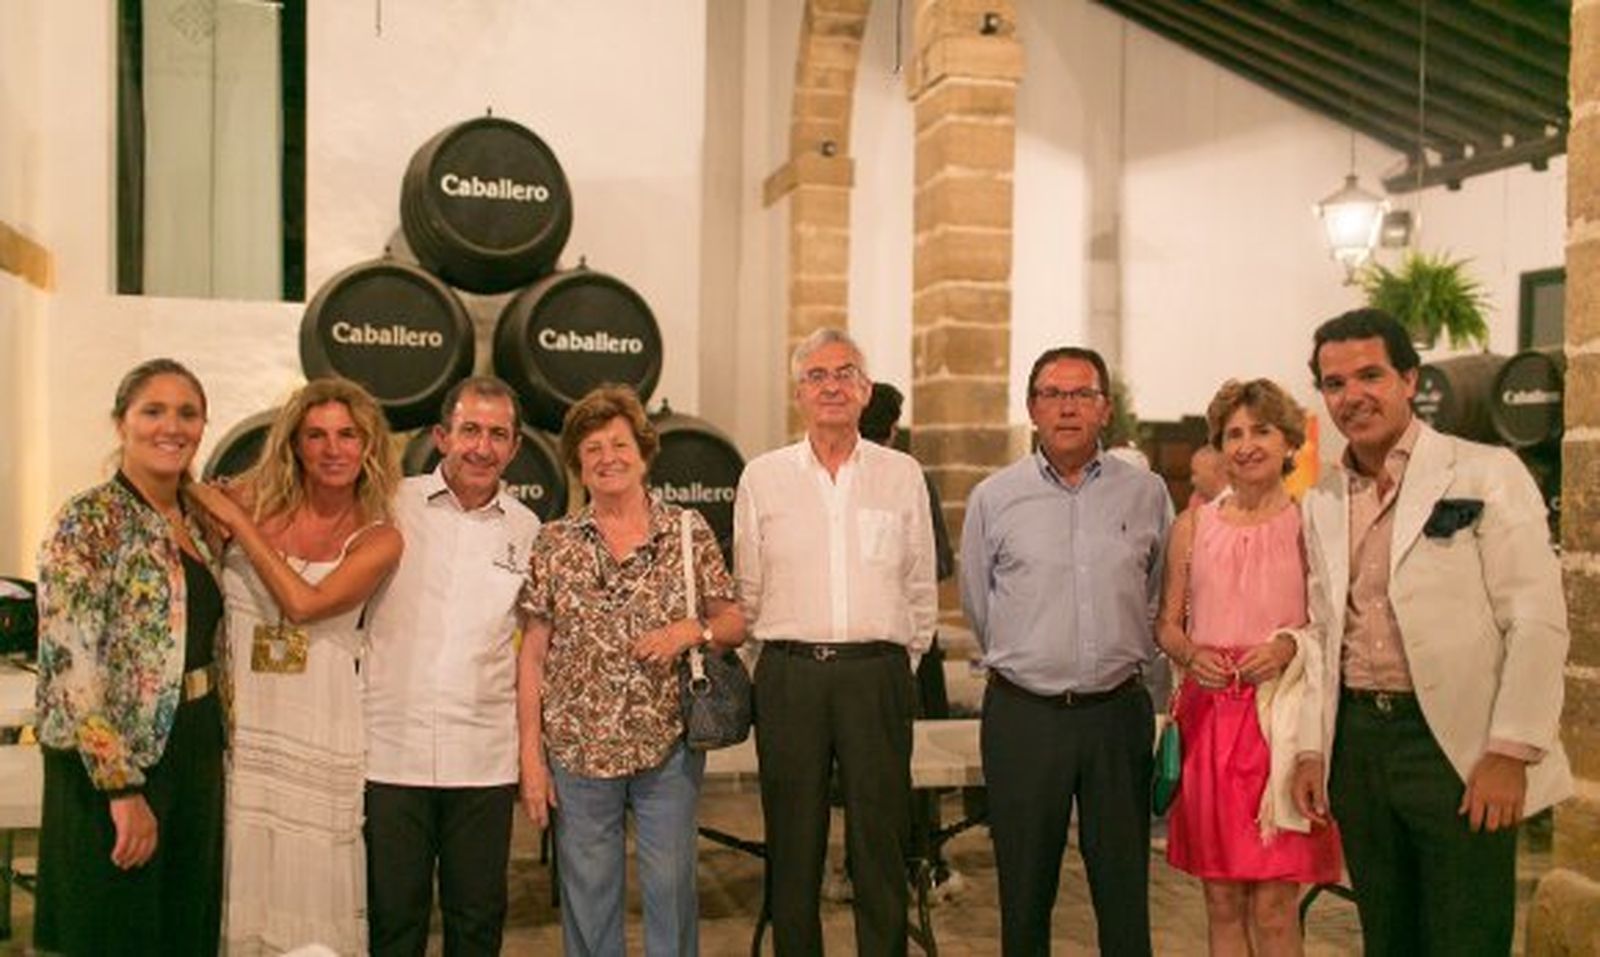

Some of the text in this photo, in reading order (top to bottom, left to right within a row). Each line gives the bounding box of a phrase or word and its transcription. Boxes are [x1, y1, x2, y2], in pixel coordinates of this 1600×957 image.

[440, 173, 550, 202] Caballero
[332, 321, 444, 347] Caballero
[538, 328, 644, 354] Caballero
[646, 482, 735, 503] aballero
